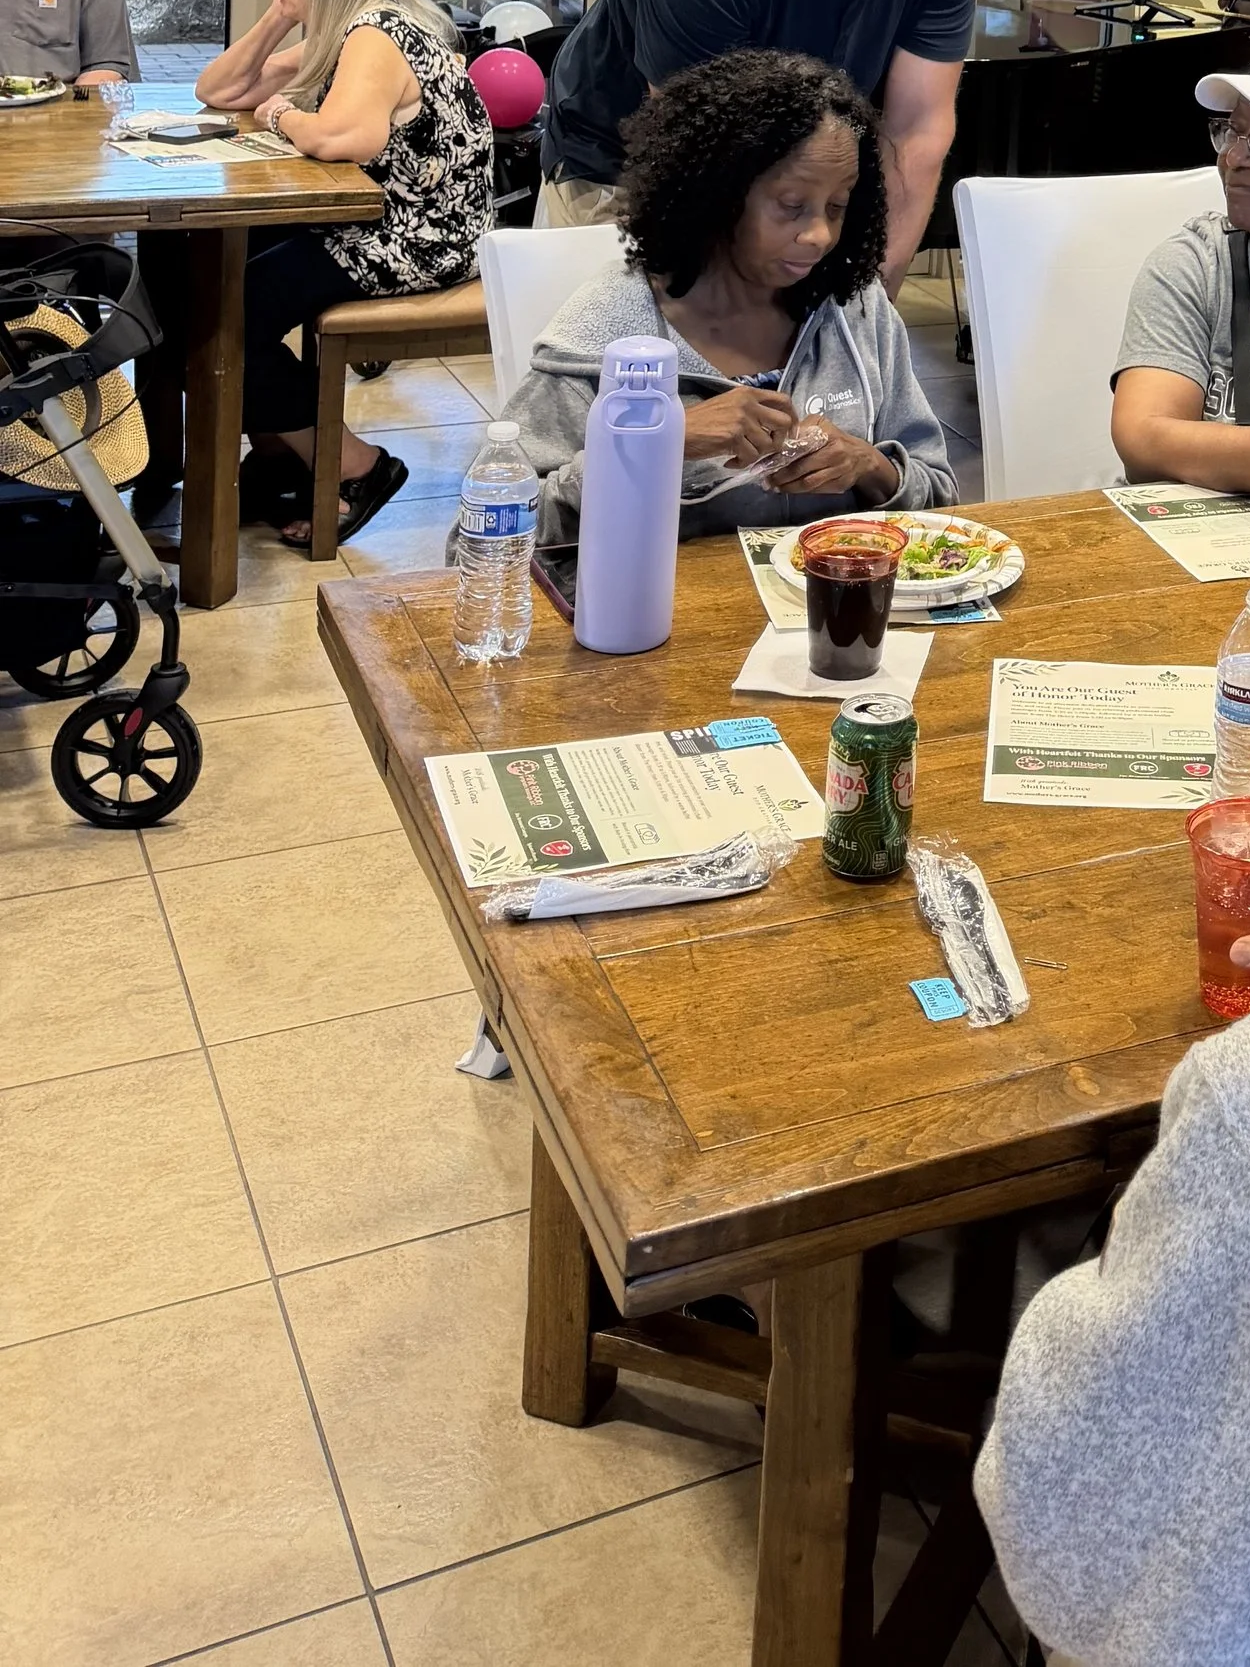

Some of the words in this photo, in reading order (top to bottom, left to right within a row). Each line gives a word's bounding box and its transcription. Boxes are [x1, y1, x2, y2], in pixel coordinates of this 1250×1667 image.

[827, 388, 854, 403] Quest
[1013, 684, 1038, 692] You
[1040, 685, 1065, 693] Are
[1067, 686, 1095, 694] Our
[1097, 687, 1138, 695] Guest
[1029, 692, 1077, 700] Honor
[1080, 694, 1125, 703] Today
[732, 732, 774, 743] TICKET
[542, 753, 555, 767] With
[1009, 747, 1035, 755] With
[1036, 749, 1083, 758] Heartfelt
[1084, 751, 1123, 759] Thanks
[1159, 754, 1207, 763] Sponsors
[1133, 764, 1154, 772] FRC
[547, 765, 566, 790] Heartfelt
[700, 767, 721, 792] Today
[715, 758, 731, 775] Our
[723, 773, 744, 796] Guest
[557, 788, 573, 809] Thanks
[755, 784, 778, 815] MOTHER'S
[567, 813, 581, 827] Our
[570, 824, 592, 852] Sponsors
[838, 838, 858, 851] ALE
[916, 982, 939, 1008] COUPON
[934, 984, 951, 1000] KEEP
